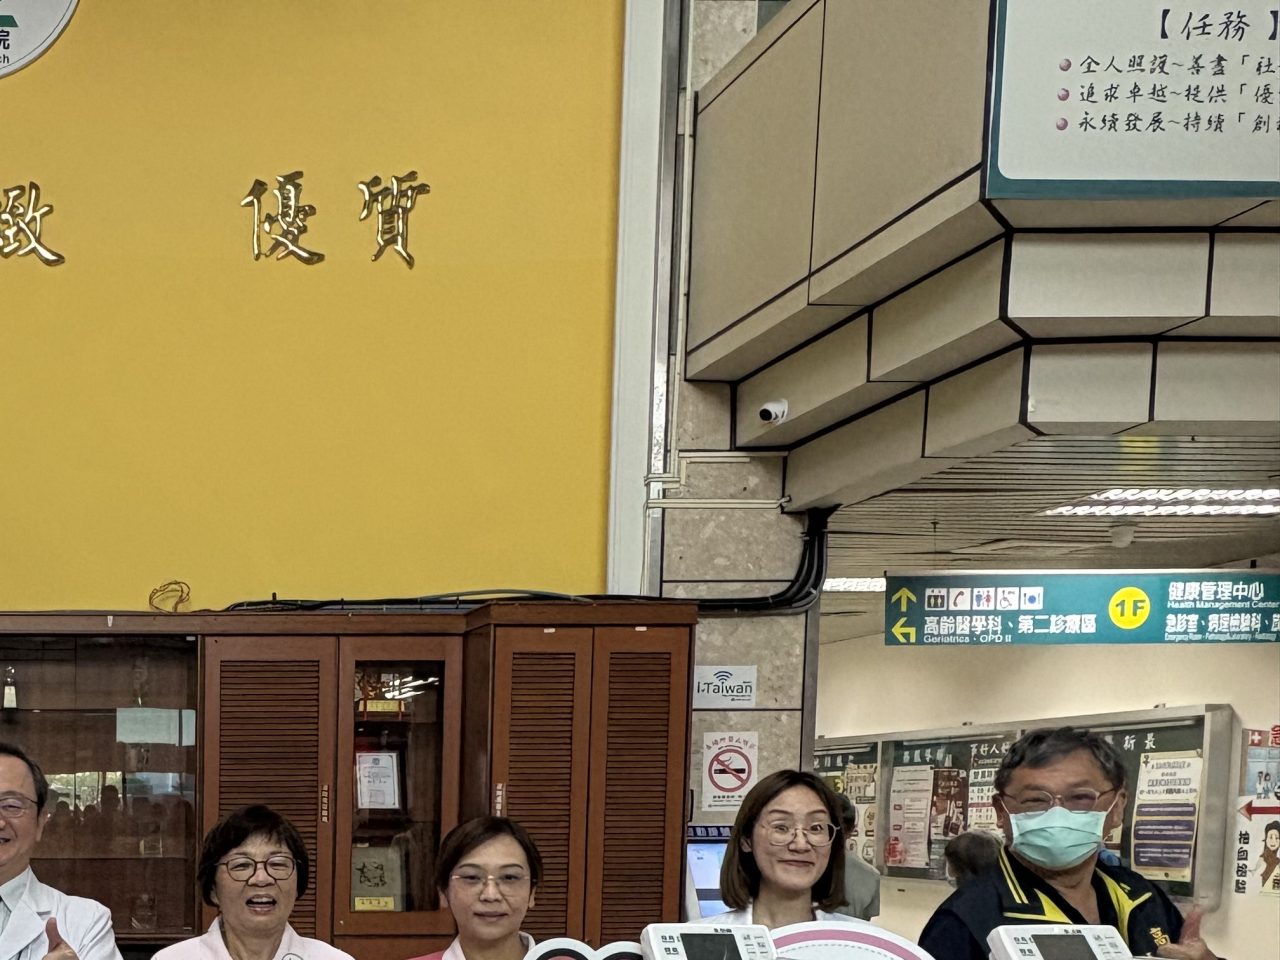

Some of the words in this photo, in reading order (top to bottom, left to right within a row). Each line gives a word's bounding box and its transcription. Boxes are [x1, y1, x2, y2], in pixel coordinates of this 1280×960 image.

[241, 170, 431, 269] 優質
[1168, 581, 1265, 601] 健康管理中心
[1115, 599, 1146, 617] 1F
